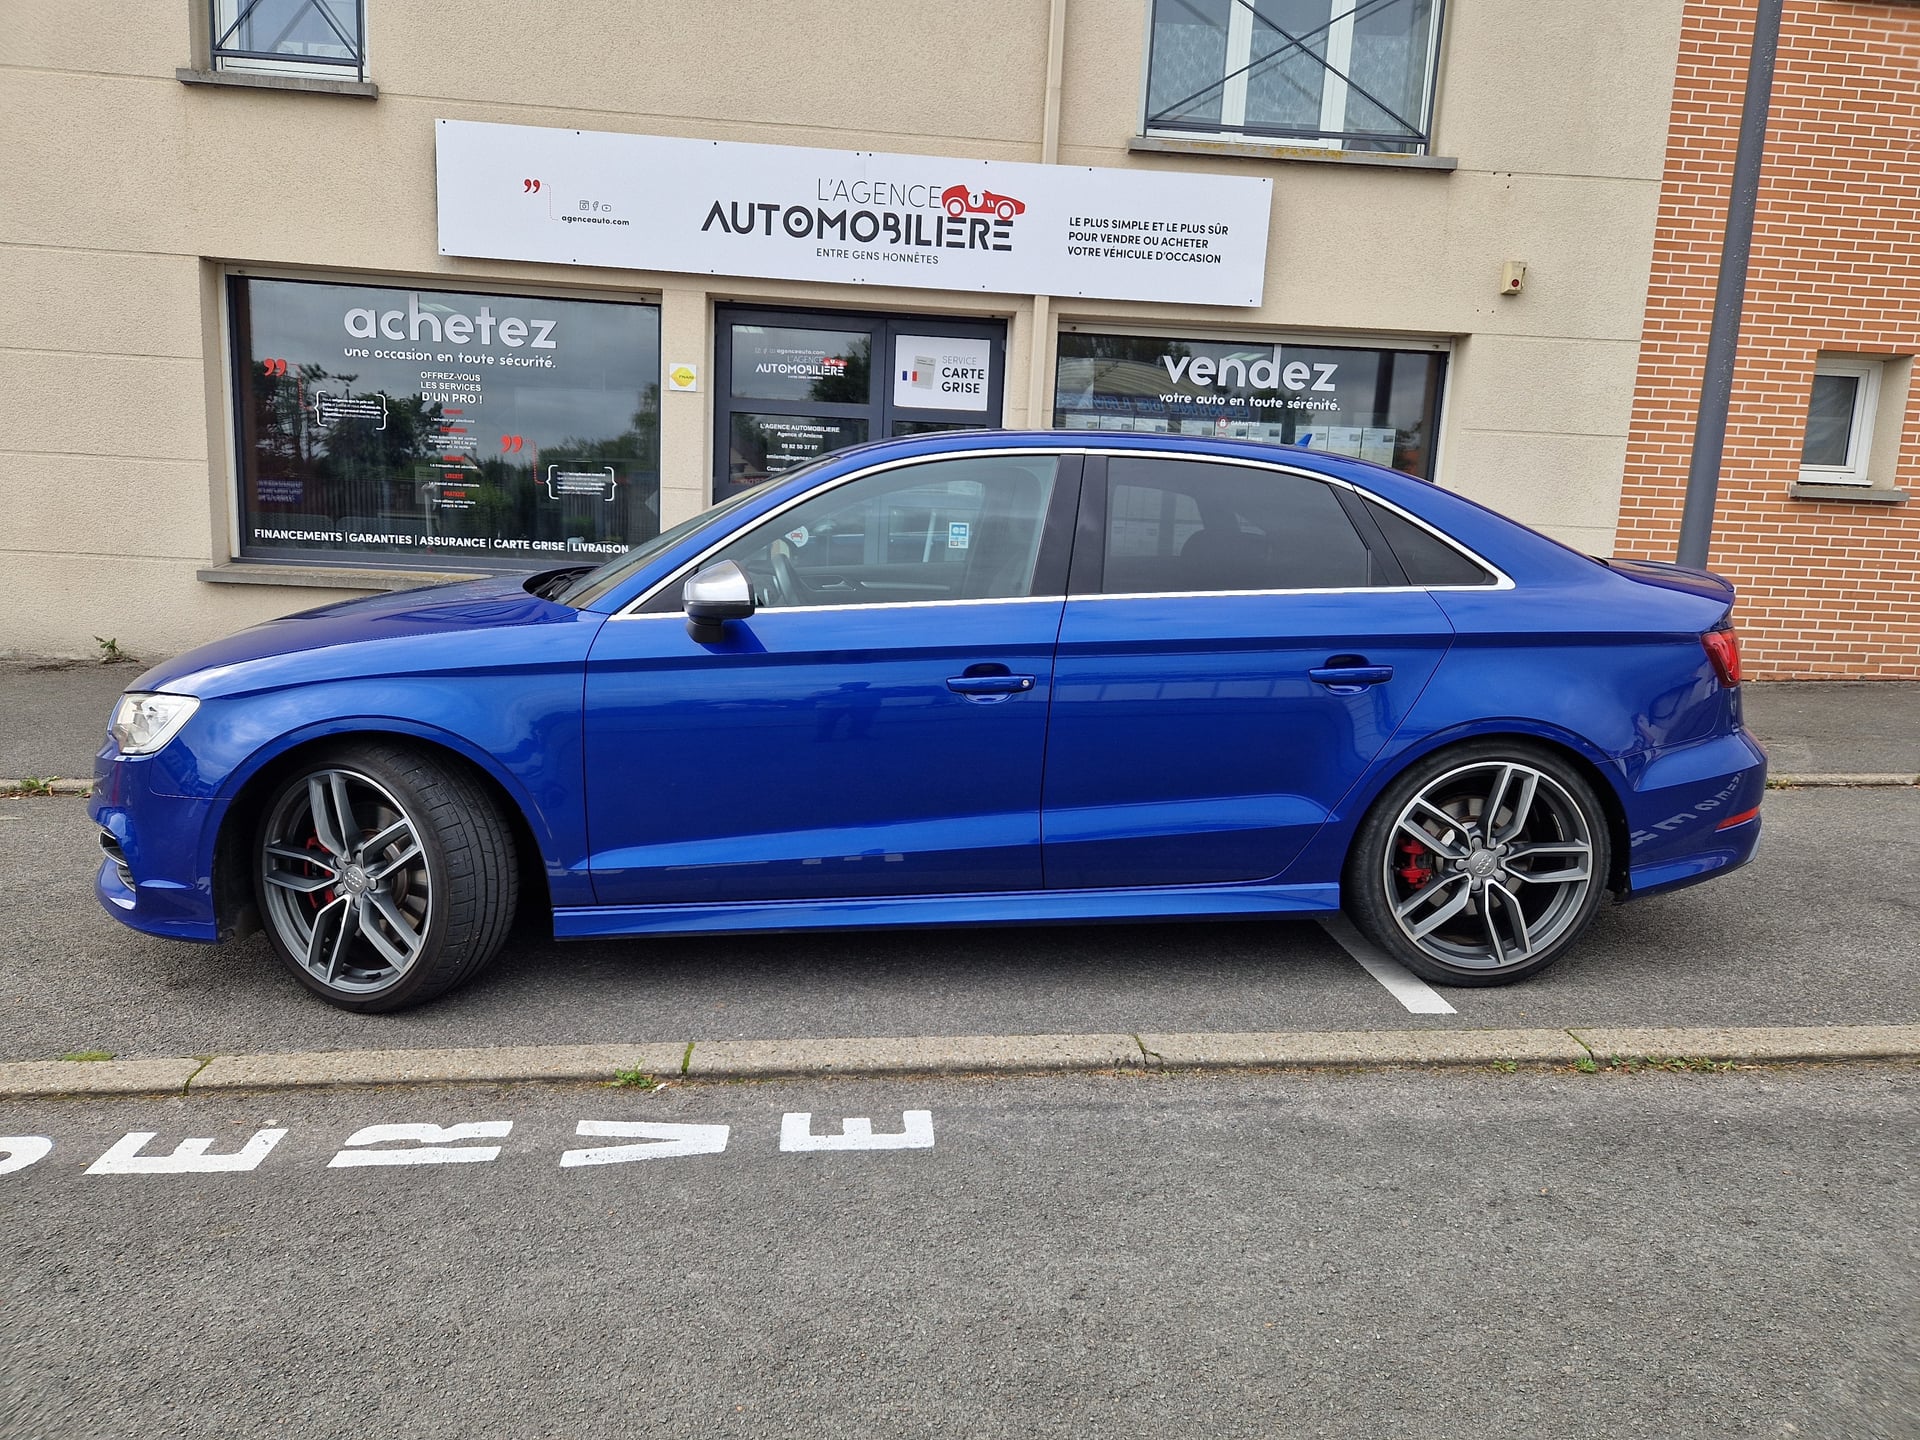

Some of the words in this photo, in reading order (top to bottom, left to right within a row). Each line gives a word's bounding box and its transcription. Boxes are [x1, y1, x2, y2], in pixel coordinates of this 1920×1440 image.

[817, 178, 942, 209] L'AGENCE
[561, 214, 630, 227] agenceauto.com
[1069, 217, 1081, 227] LE
[1083, 218, 1109, 229] PLUS
[1112, 219, 1149, 231] SIMPLE
[1152, 222, 1164, 231] ET
[1166, 223, 1177, 232] LE
[1180, 224, 1206, 234] PLUS
[1208, 222, 1228, 235] SÛR
[1068, 232, 1098, 242] POUR
[1100, 233, 1141, 245] VENDRE
[1143, 236, 1159, 246] OU
[1161, 237, 1209, 248] ACHETER
[816, 248, 849, 259] ENTRE
[852, 250, 880, 261] GENS
[882, 251, 939, 265] HONNÊTES
[1067, 246, 1101, 257] VOTRE
[1103, 245, 1153, 260] VÉHICULE
[1155, 251, 1221, 263] D'OCCASION
[343, 294, 557, 349] achetez
[344, 348, 370, 359] une
[374, 348, 433, 362] occasion
[437, 352, 453, 363] en
[458, 352, 494, 366] toute
[500, 353, 556, 369] sécurité.
[787, 355, 823, 365] L'AGENCE
[942, 355, 977, 365] SERVICE
[420, 370, 481, 382] OFFREZ-VOUS
[941, 367, 985, 380] CARTE
[1162, 344, 1340, 392] vendez
[420, 381, 437, 390] LES
[439, 382, 482, 392] SERVICES
[941, 381, 981, 394] GRISE
[421, 391, 448, 403] D'UN
[450, 393, 475, 405] PRO
[1159, 392, 1191, 405] votre
[1196, 394, 1225, 406] auto
[1229, 397, 1245, 407] en
[1249, 396, 1283, 409] toute
[1286, 396, 1341, 412] sérénité.
[760, 423, 790, 431] L'AGENCE
[254, 528, 342, 543] FINANCEMENTS
[349, 533, 412, 545] GARANTIES
[419, 536, 486, 549] ASSURANCE
[494, 539, 530, 551] CARTE
[532, 540, 566, 552] GRISE
[572, 542, 629, 555] LIVRAISON
